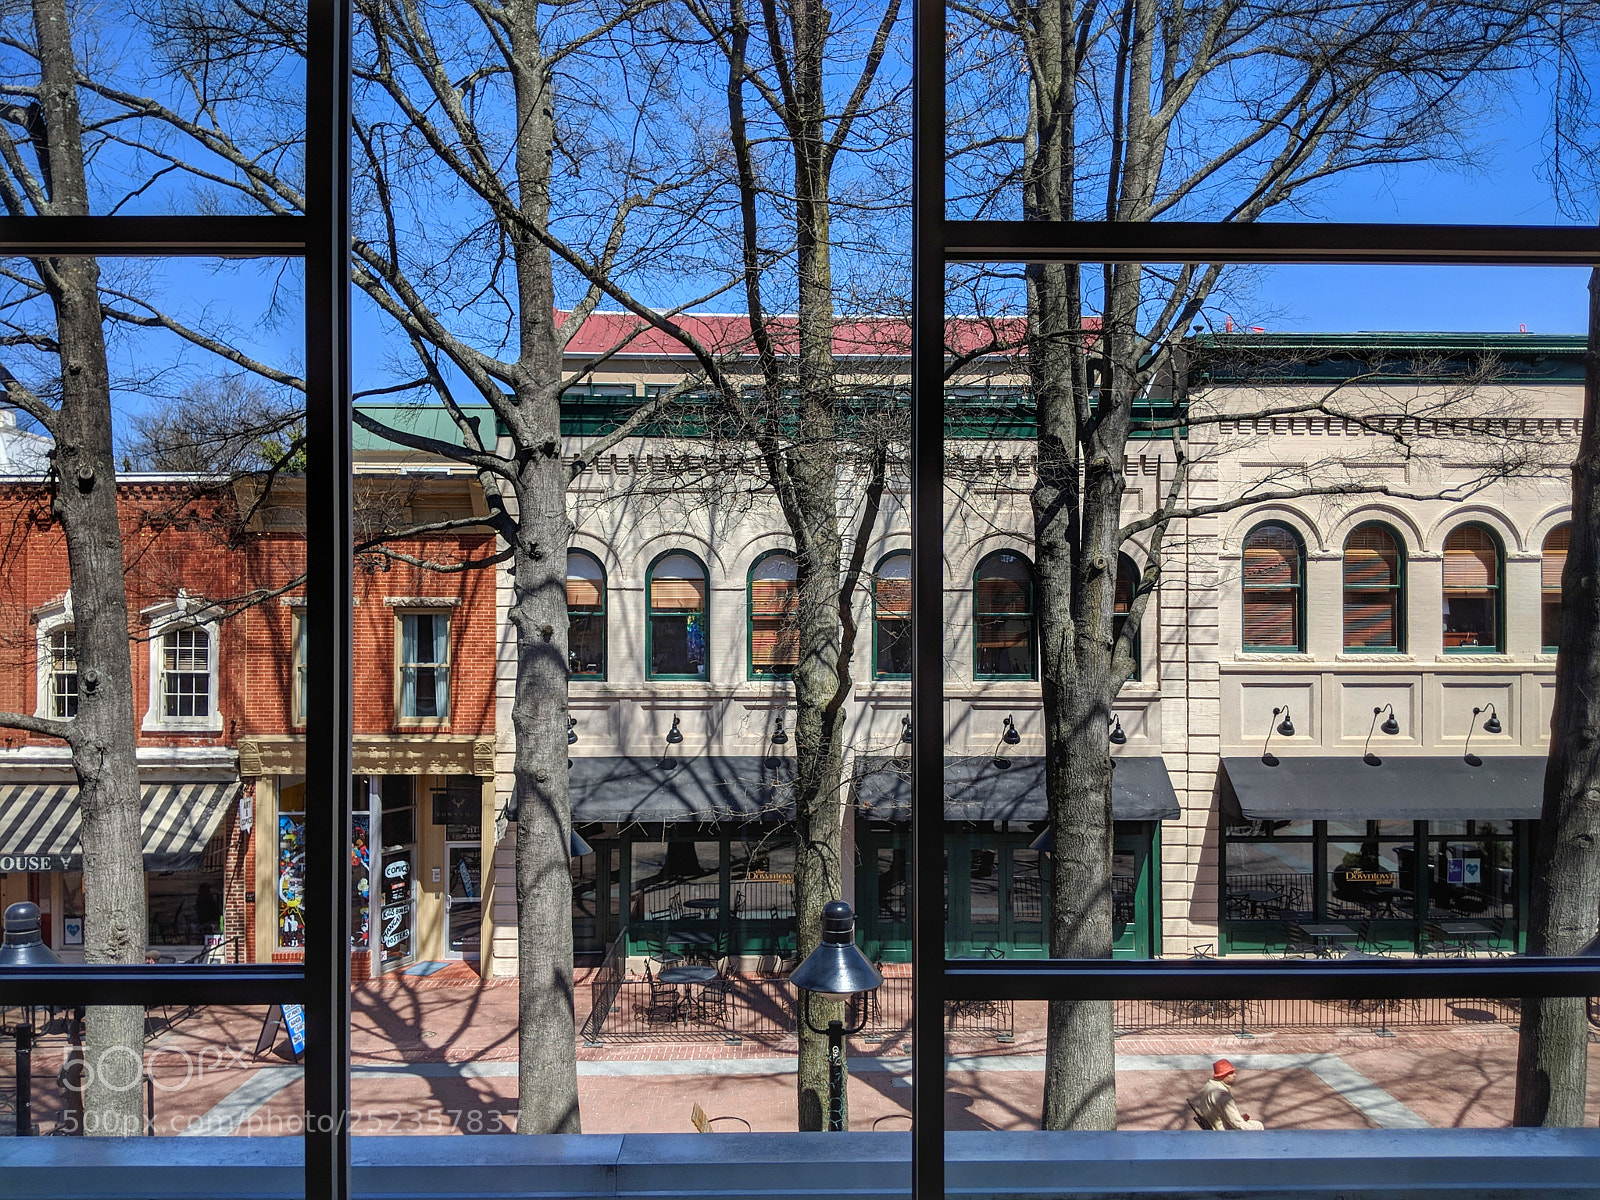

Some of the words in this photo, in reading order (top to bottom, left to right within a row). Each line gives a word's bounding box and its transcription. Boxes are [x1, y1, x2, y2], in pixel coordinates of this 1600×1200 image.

[0, 856, 52, 871] OUSE
[386, 864, 409, 876] COMICS
[1345, 871, 1397, 880] Downtown
[387, 930, 409, 945] POSTERS
